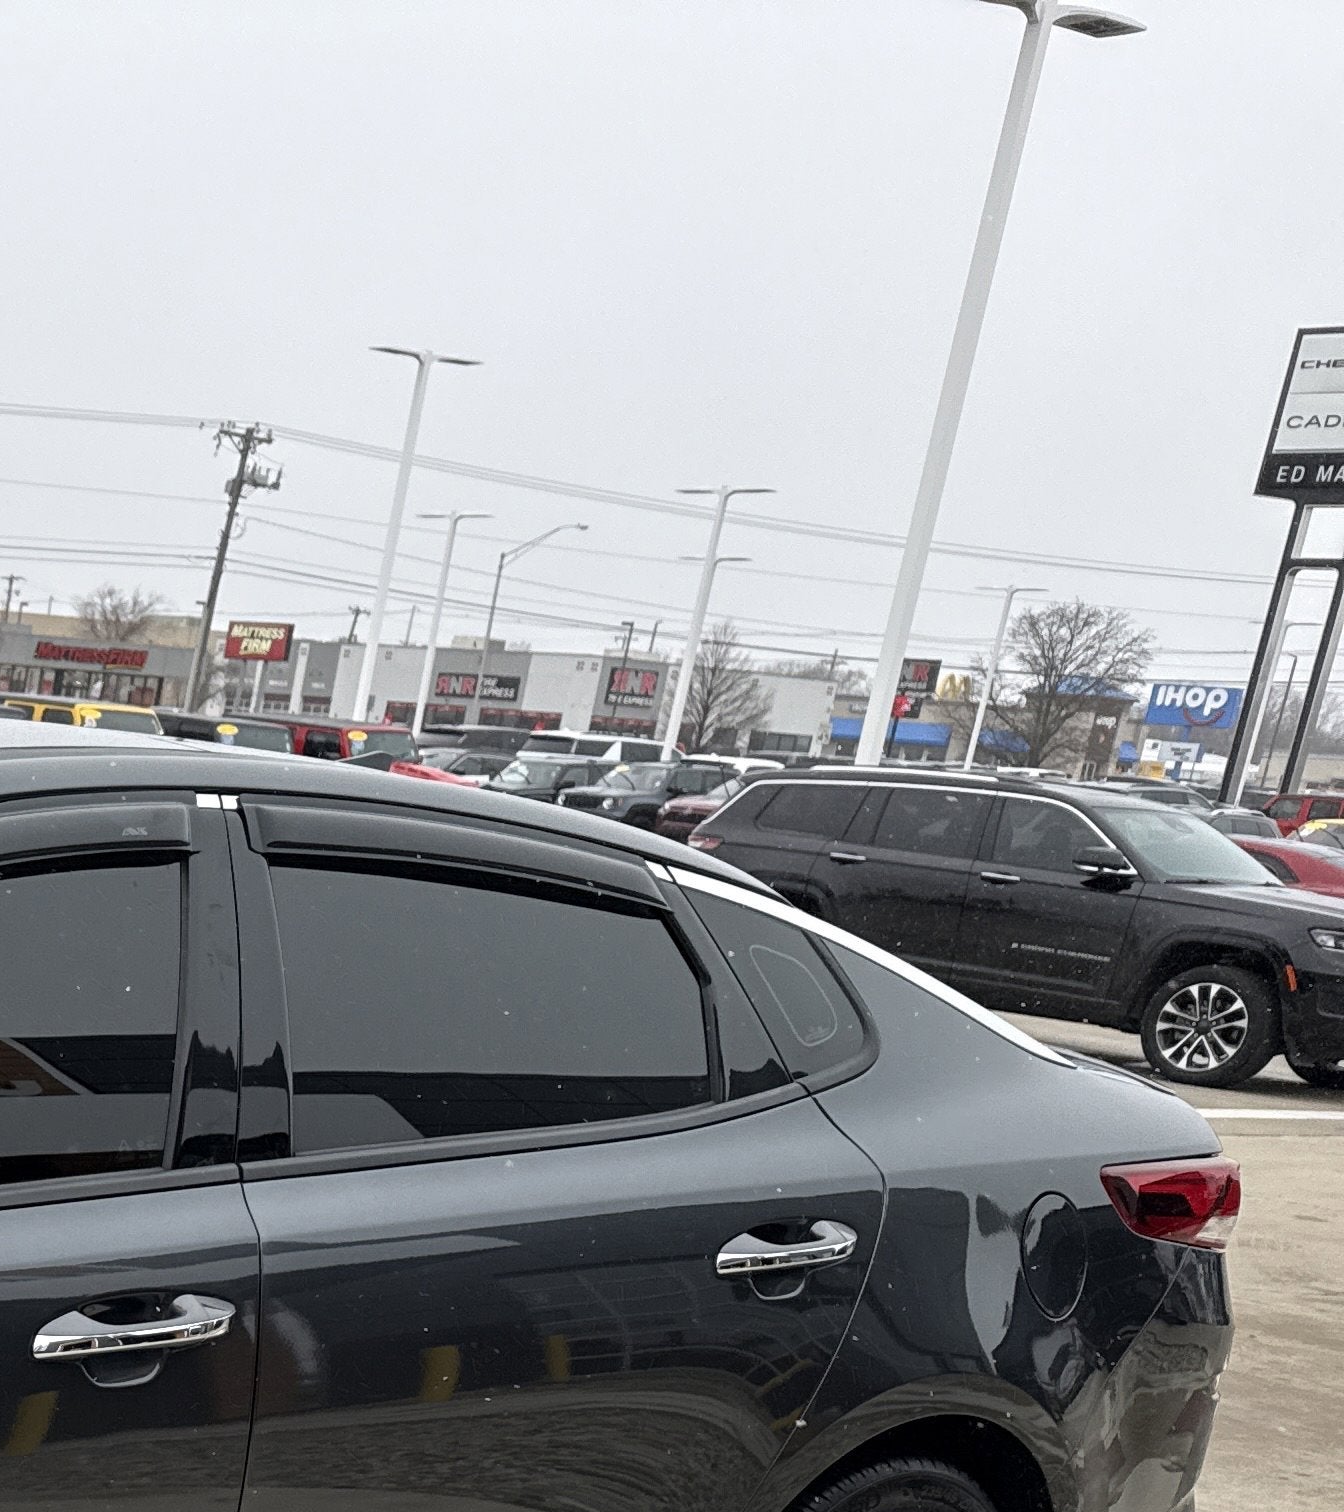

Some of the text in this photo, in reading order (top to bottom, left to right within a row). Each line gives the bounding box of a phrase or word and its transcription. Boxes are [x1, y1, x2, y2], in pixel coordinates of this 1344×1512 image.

[1286, 414, 1344, 428] CAD
[1276, 465, 1306, 482] ED
[231, 624, 286, 640] MATTRESS
[1156, 685, 1229, 717] IHOP
